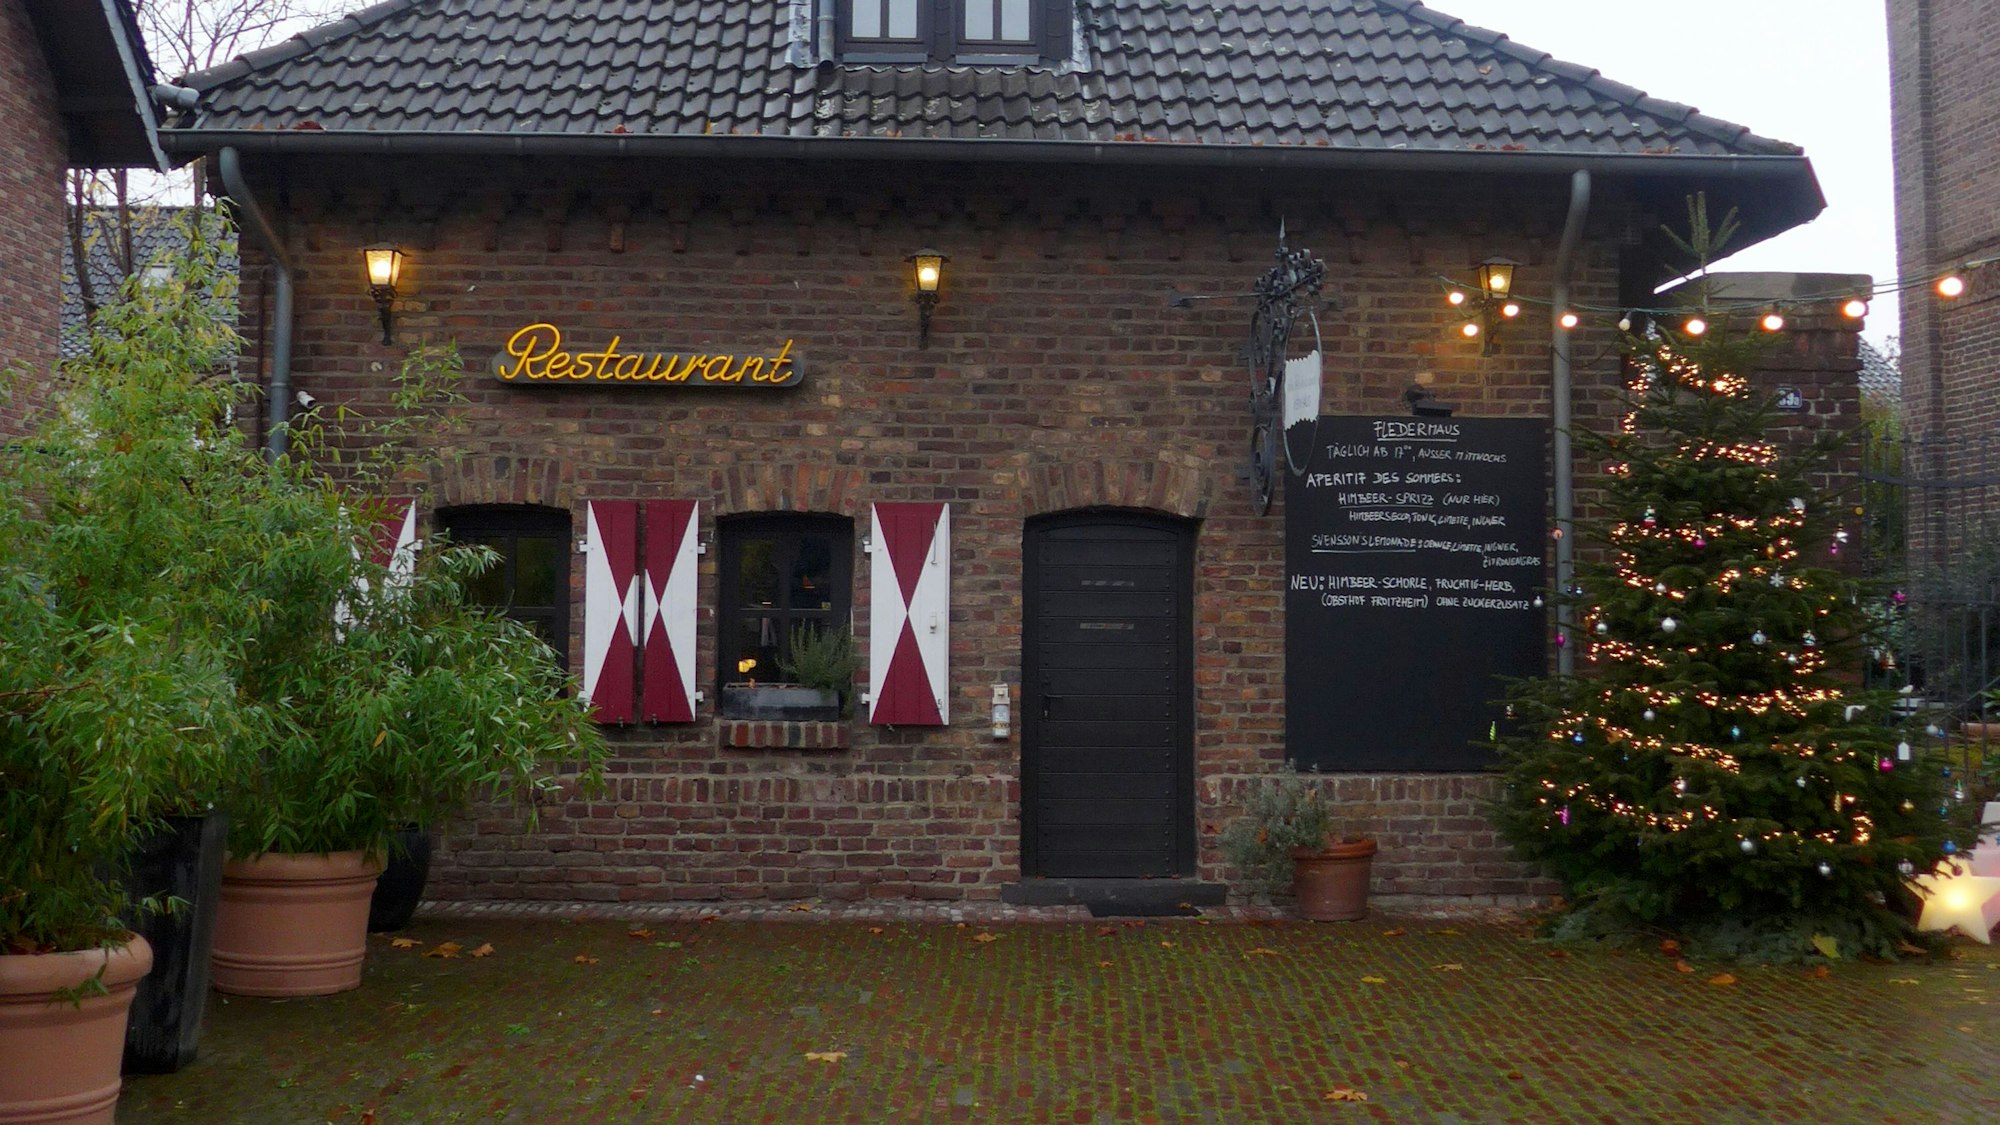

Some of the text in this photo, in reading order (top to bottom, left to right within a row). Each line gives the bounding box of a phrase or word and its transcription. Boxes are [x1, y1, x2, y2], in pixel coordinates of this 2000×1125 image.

[500, 323, 794, 383] Restaurant
[1373, 421, 1460, 438] FLEDERMAUS
[1326, 443, 1370, 459] TÄGLICH
[1373, 446, 1388, 457] AB
[1418, 449, 1451, 460] AUSSER
[1306, 472, 1462, 488] APERITIF DES SOMMERS:
[1442, 493, 1470, 506] (NUR
[1291, 574, 1325, 590] NEU:
[1322, 592, 1366, 607] (OBSTHOF
[1436, 596, 1460, 607] OHNE
